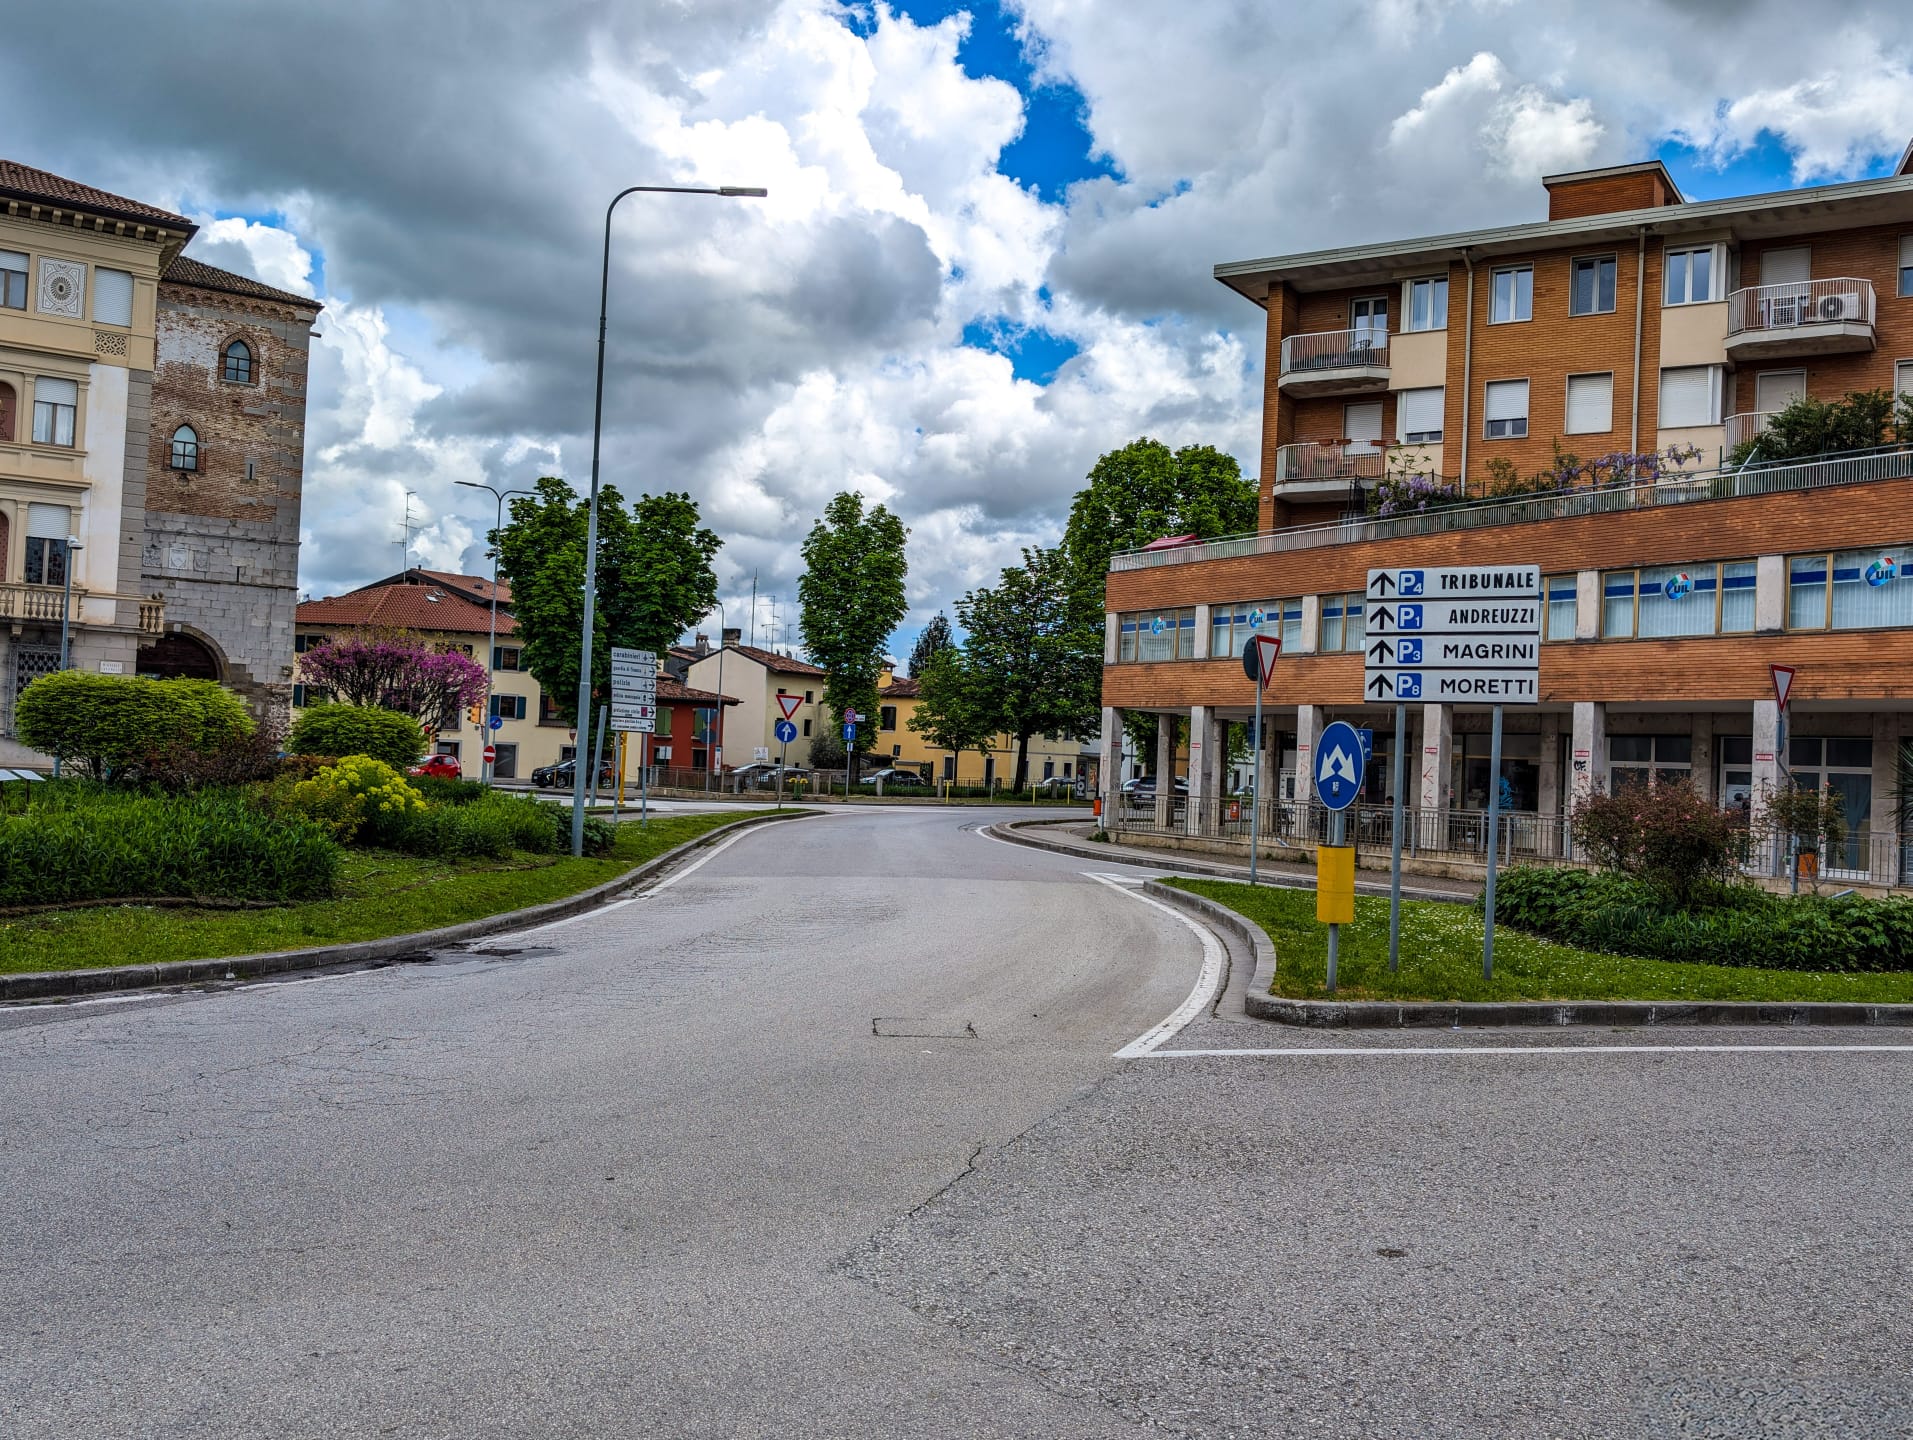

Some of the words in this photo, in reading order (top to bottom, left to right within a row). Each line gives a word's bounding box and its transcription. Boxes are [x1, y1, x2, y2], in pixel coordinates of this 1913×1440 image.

[1400, 574, 1422, 594] P4
[1441, 573, 1533, 589] TRIBUNALE
[1876, 570, 1895, 579] UIL
[1400, 608, 1421, 627] P1
[1449, 608, 1534, 624] ANDREUZZI
[1399, 642, 1421, 661] P3
[1444, 644, 1533, 659] MAGRINI
[1398, 676, 1420, 695] P8
[1441, 679, 1532, 694] MORETTI
